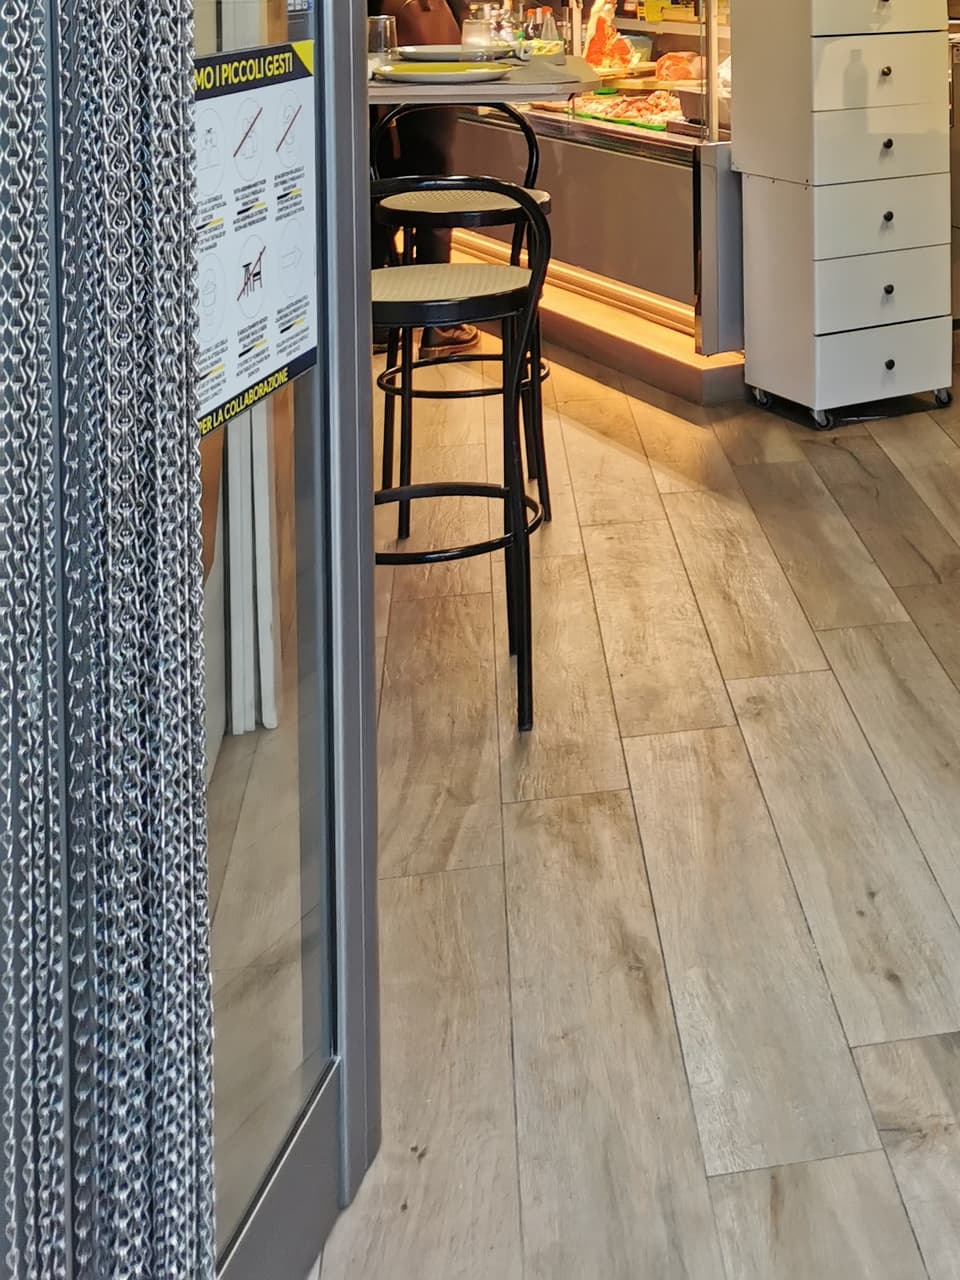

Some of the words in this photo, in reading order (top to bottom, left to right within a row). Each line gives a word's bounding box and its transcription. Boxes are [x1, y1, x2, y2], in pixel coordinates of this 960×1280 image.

[221, 57, 264, 86] PICCOLI
[265, 52, 293, 77] GESTI
[213, 409, 224, 427] LA
[224, 367, 289, 419] COLLABORAZIONE
